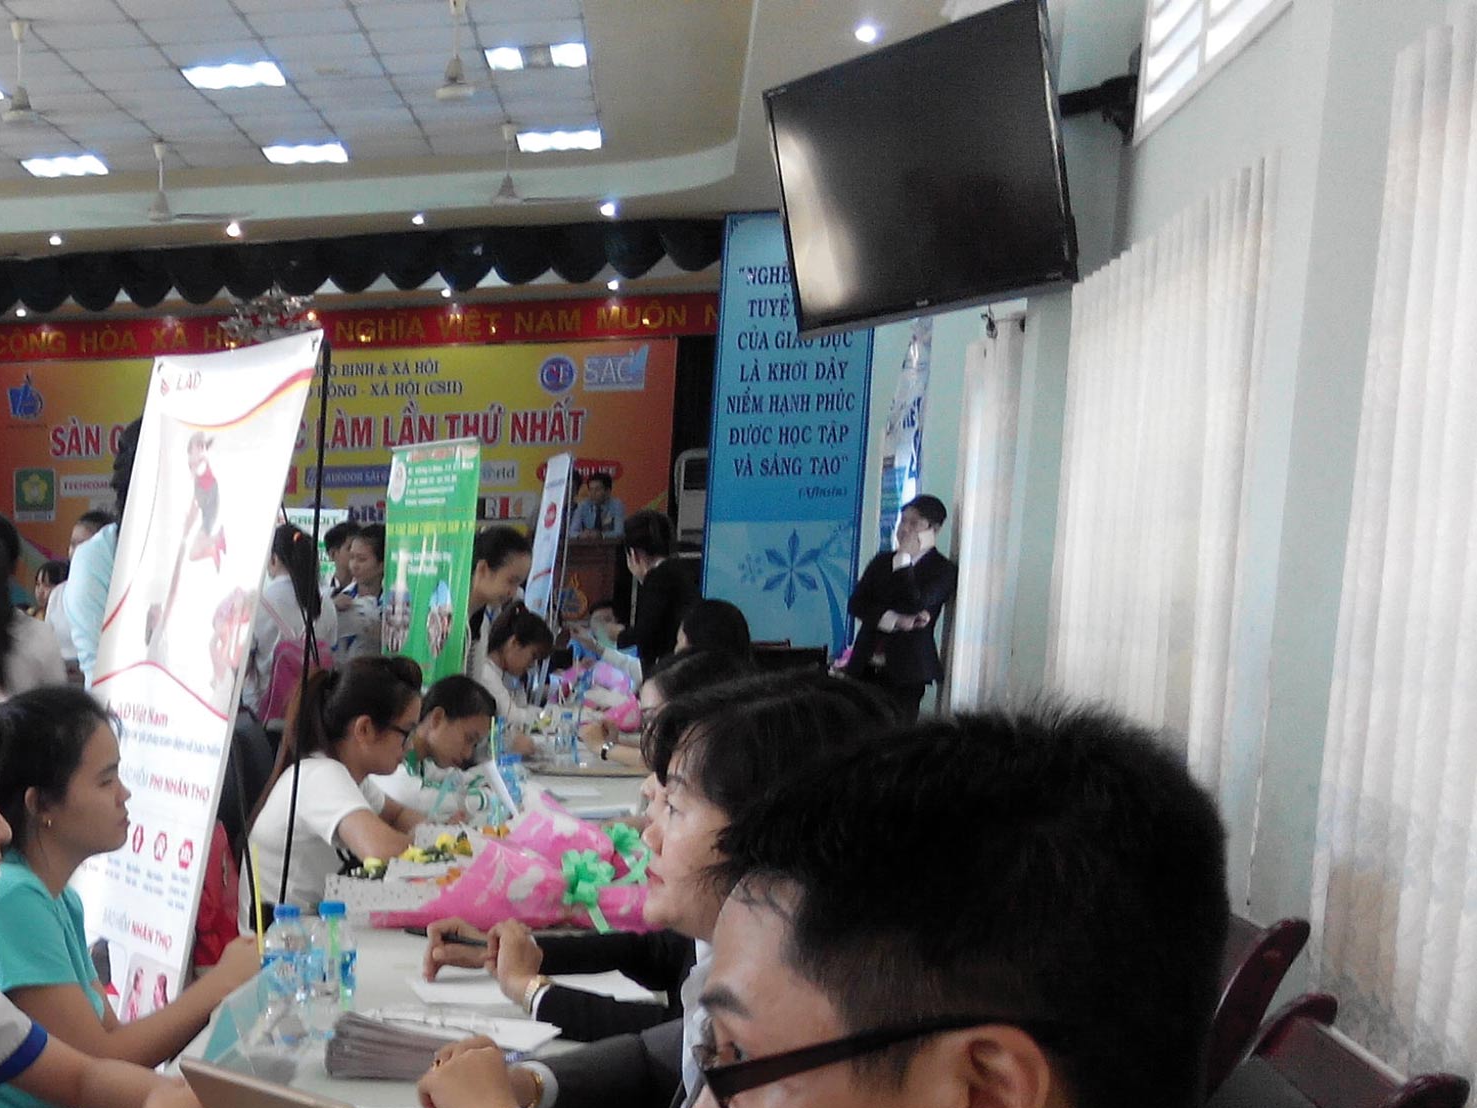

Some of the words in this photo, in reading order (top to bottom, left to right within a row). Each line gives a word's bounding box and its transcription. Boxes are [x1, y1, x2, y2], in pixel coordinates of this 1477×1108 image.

[81, 324, 137, 351] HÒA
[151, 320, 188, 349] XÃ
[335, 312, 424, 343] NGHĨA
[438, 311, 502, 342] VIỆT
[514, 309, 581, 334] NAM
[596, 301, 687, 330] MUÔN
[737, 325, 769, 351] CỦA
[415, 358, 439, 375] HỘI
[740, 358, 760, 382] LÀ
[395, 378, 420, 398] HỘI
[726, 386, 762, 414] NIỀM
[768, 394, 810, 418] HẠNH
[816, 388, 855, 411] PHÚC
[382, 401, 435, 447] LẦN
[445, 403, 503, 443] THỨ
[510, 397, 586, 443] NHẤT
[729, 424, 772, 446] ĐƯỢC
[779, 427, 812, 449] HỌC
[819, 422, 849, 448] TẬP
[50, 417, 101, 456] SÀN
[734, 454, 753, 477] VÀ
[760, 452, 802, 476] SÁNG
